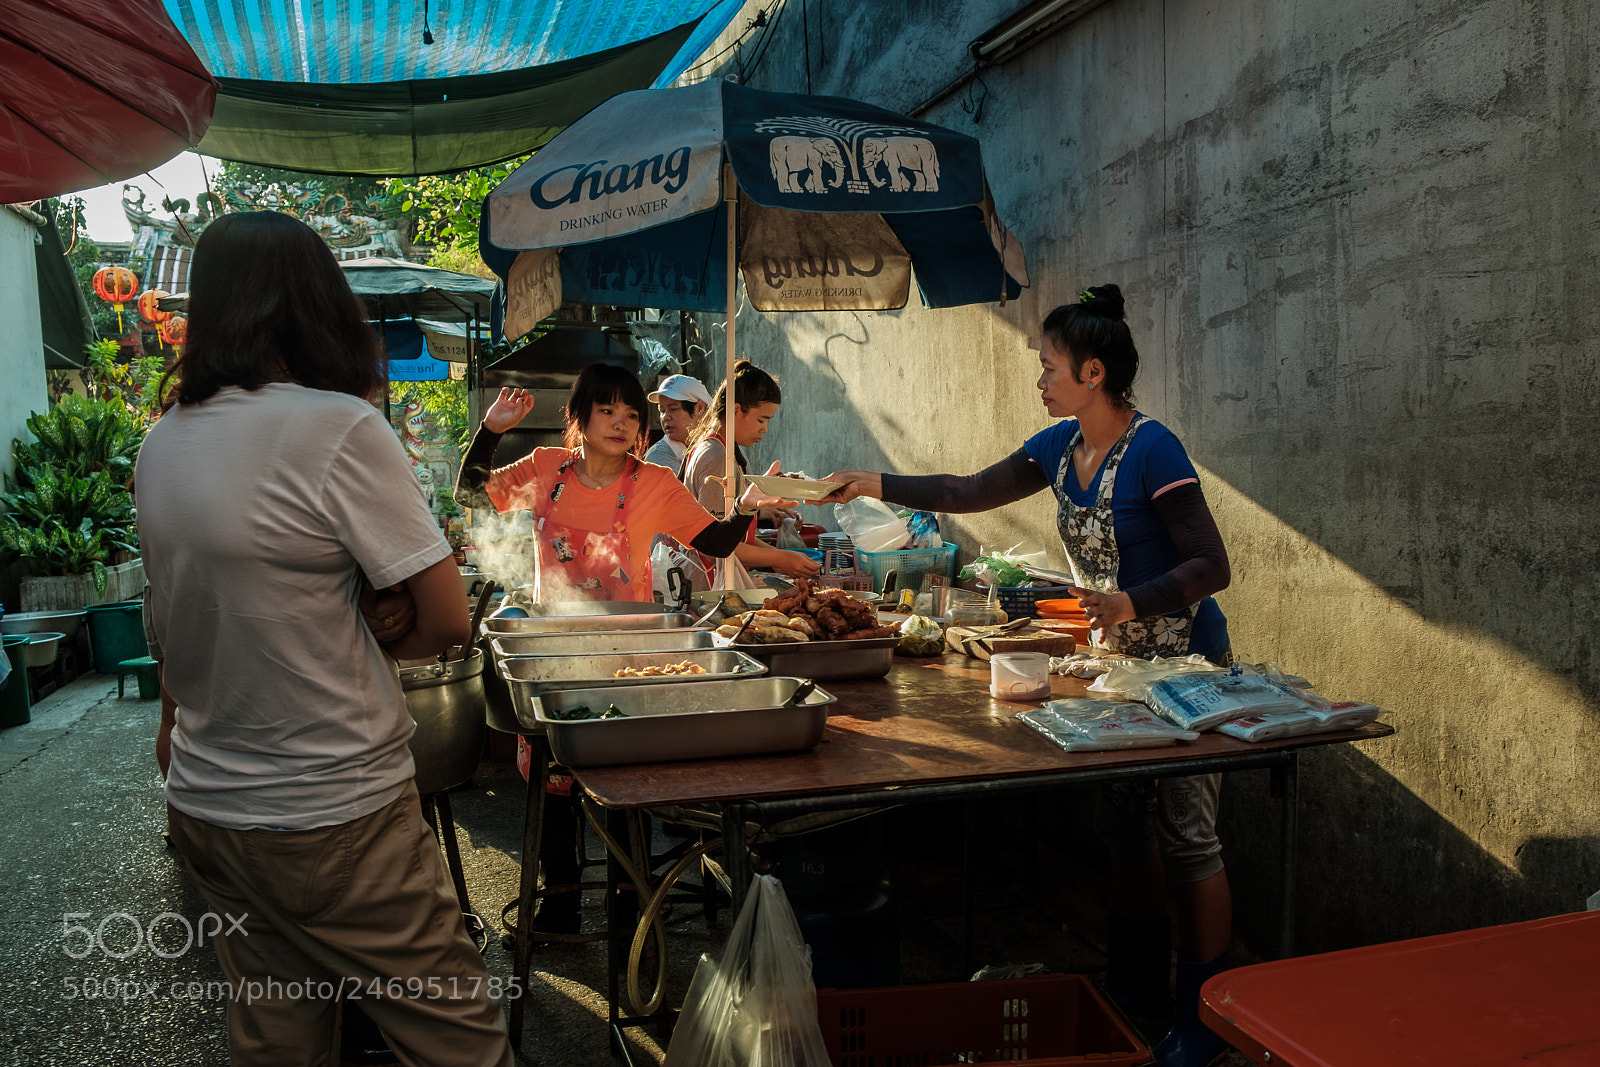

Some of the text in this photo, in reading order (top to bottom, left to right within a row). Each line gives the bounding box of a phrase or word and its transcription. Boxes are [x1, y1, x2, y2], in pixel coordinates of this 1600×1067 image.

[530, 146, 692, 210] Chang
[559, 198, 669, 232] DRINKING WATER
